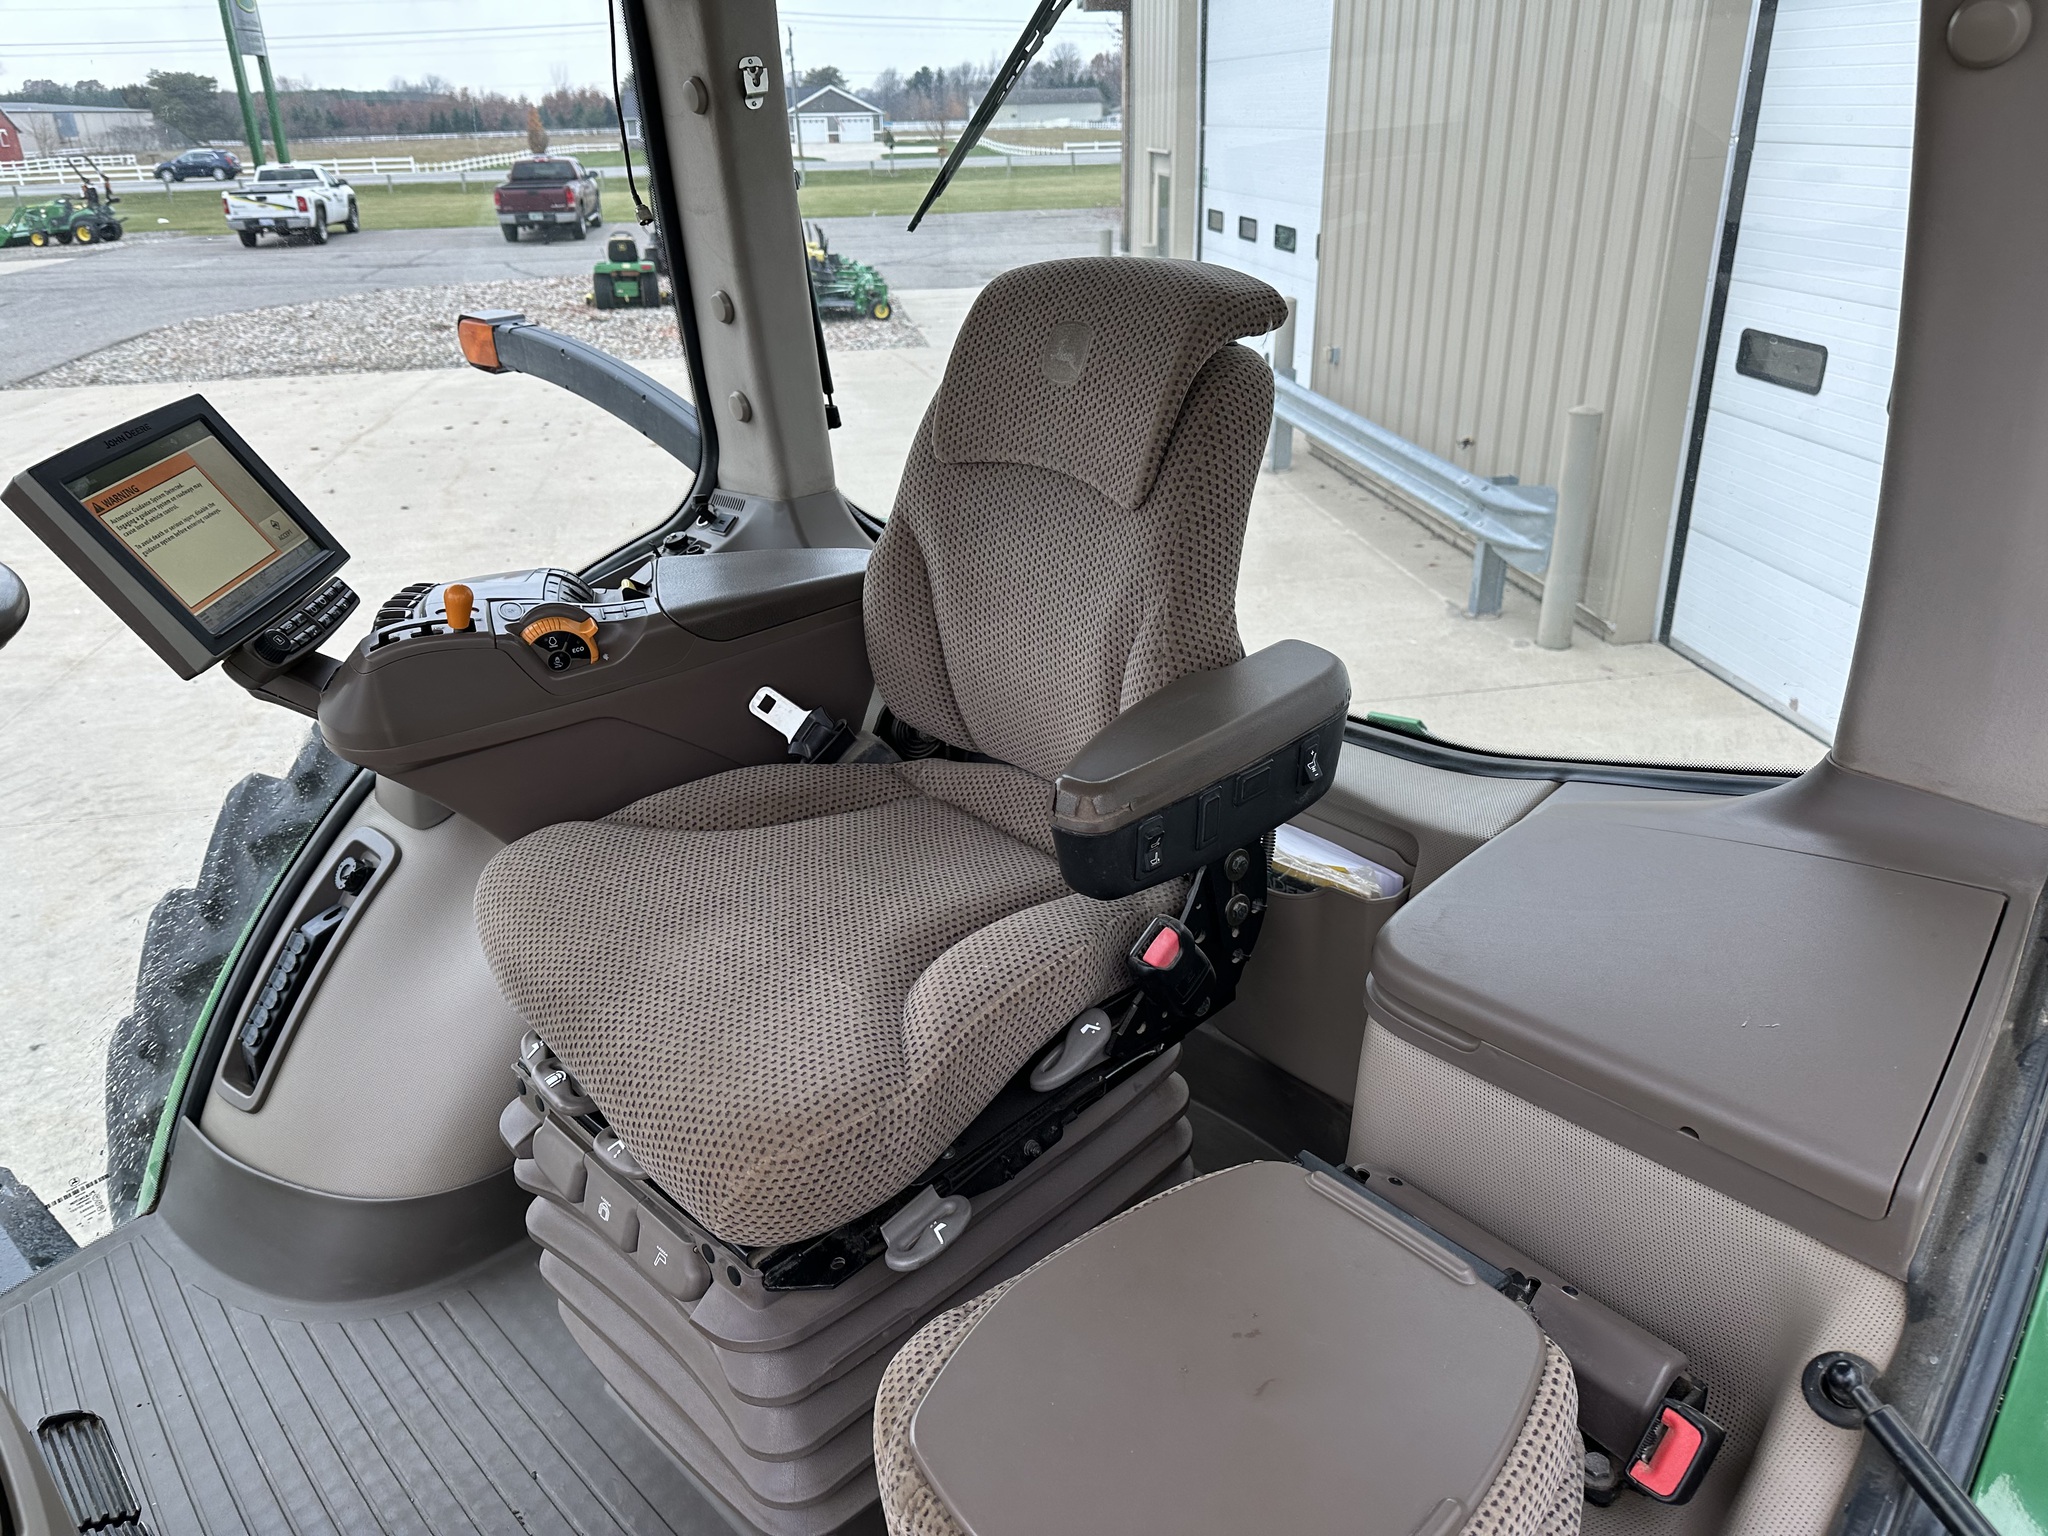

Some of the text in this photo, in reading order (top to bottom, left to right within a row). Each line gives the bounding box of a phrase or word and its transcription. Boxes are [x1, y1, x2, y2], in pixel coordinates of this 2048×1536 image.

[104, 423, 152, 449] JOHN DEERE
[101, 485, 140, 507] WARNING
[109, 510, 134, 525] Automatic
[131, 500, 152, 513] Guidance
[149, 493, 166, 503] System
[116, 518, 138, 531] Engaging
[138, 507, 158, 521] guidance
[156, 499, 172, 510] system
[123, 528, 137, 537] cause
[134, 523, 146, 531] loss
[148, 513, 164, 523] vehicle
[151, 531, 165, 541] death
[142, 543, 161, 558] guidance
[159, 535, 176, 546] system
[172, 527, 188, 537] before
[572, 646, 585, 654] ECO
